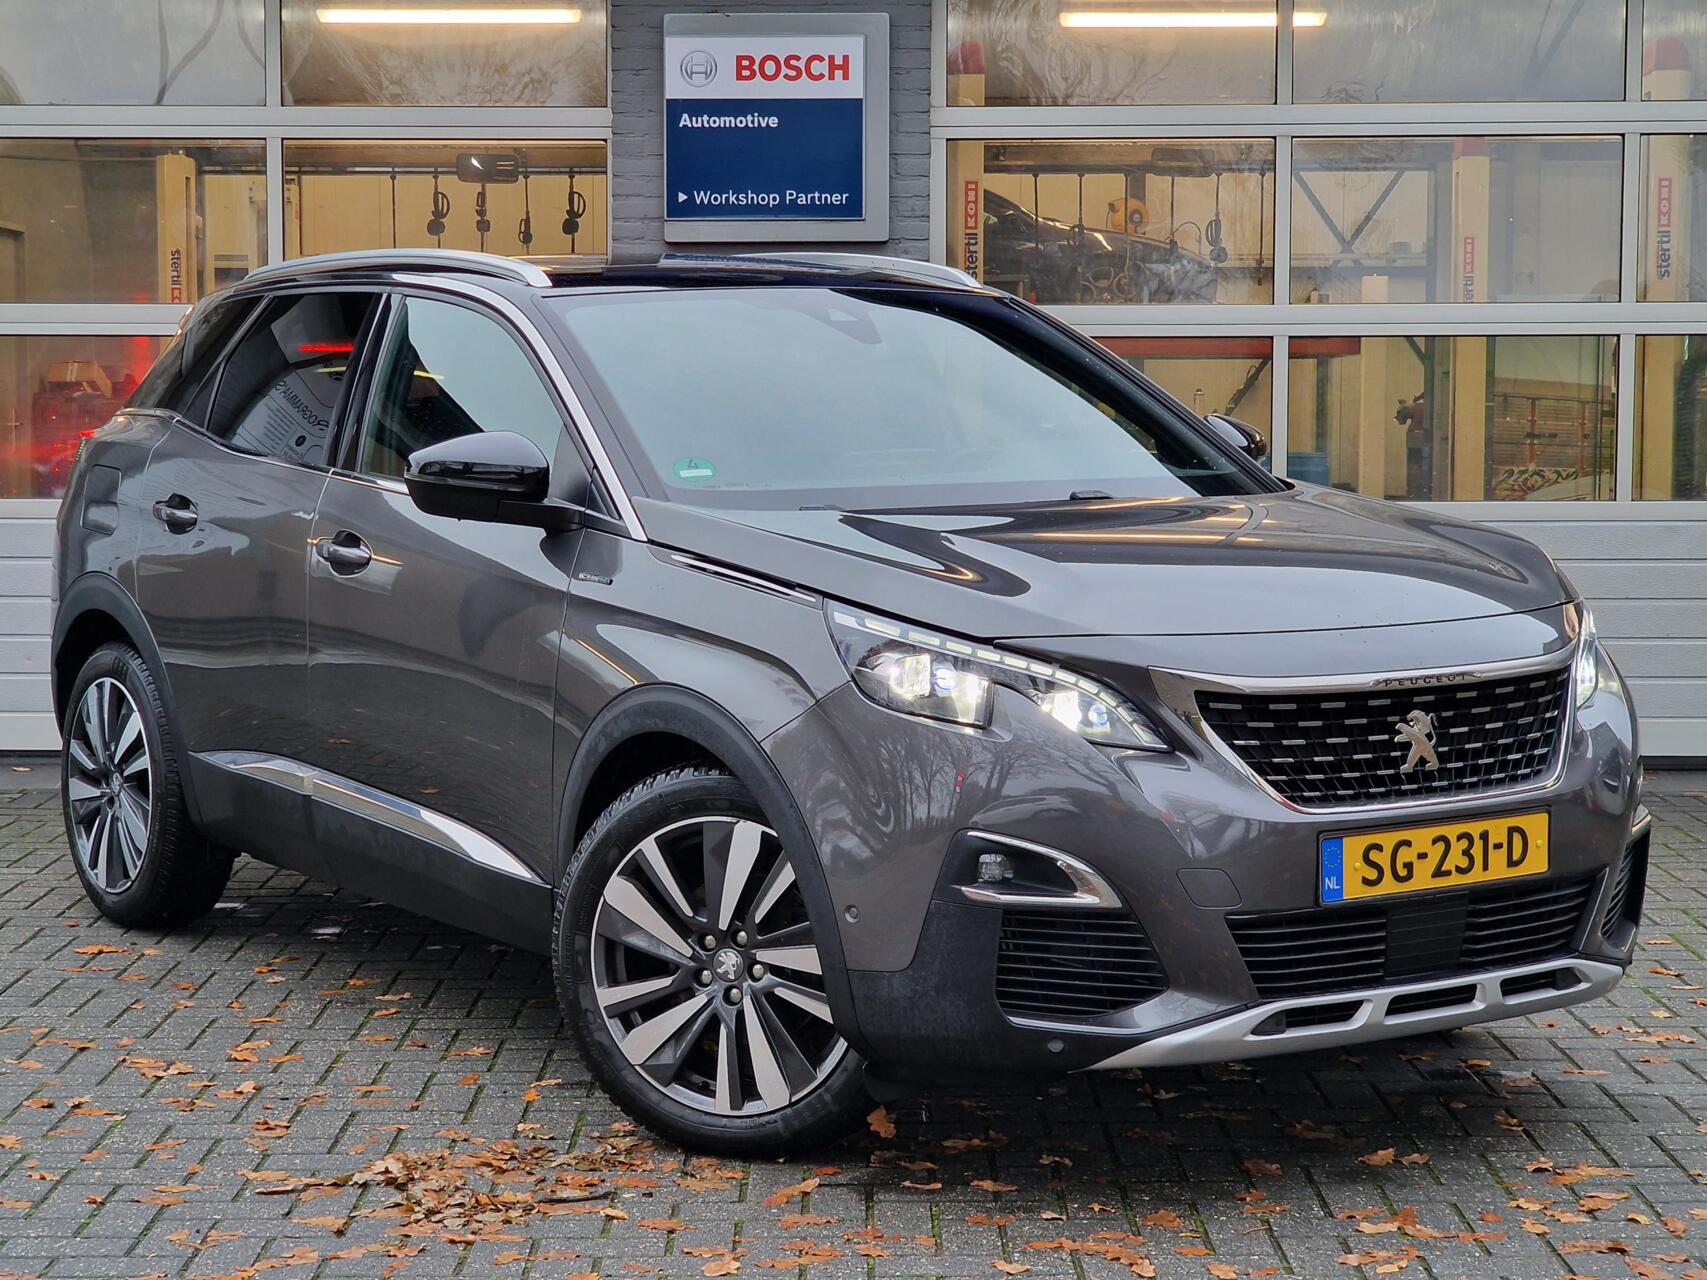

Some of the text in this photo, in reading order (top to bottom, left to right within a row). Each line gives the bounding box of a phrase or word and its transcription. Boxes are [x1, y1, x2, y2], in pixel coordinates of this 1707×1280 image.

[735, 53, 850, 82] BOSCH
[678, 112, 779, 128] Automotive
[693, 189, 850, 208] Workshop Partner
[170, 248, 182, 286] stertil
[1657, 230, 1671, 280] stertil
[1384, 673, 1466, 688] PEUGEOT
[1360, 825, 1529, 887] SG-231-D
[1324, 876, 1341, 890] NL
